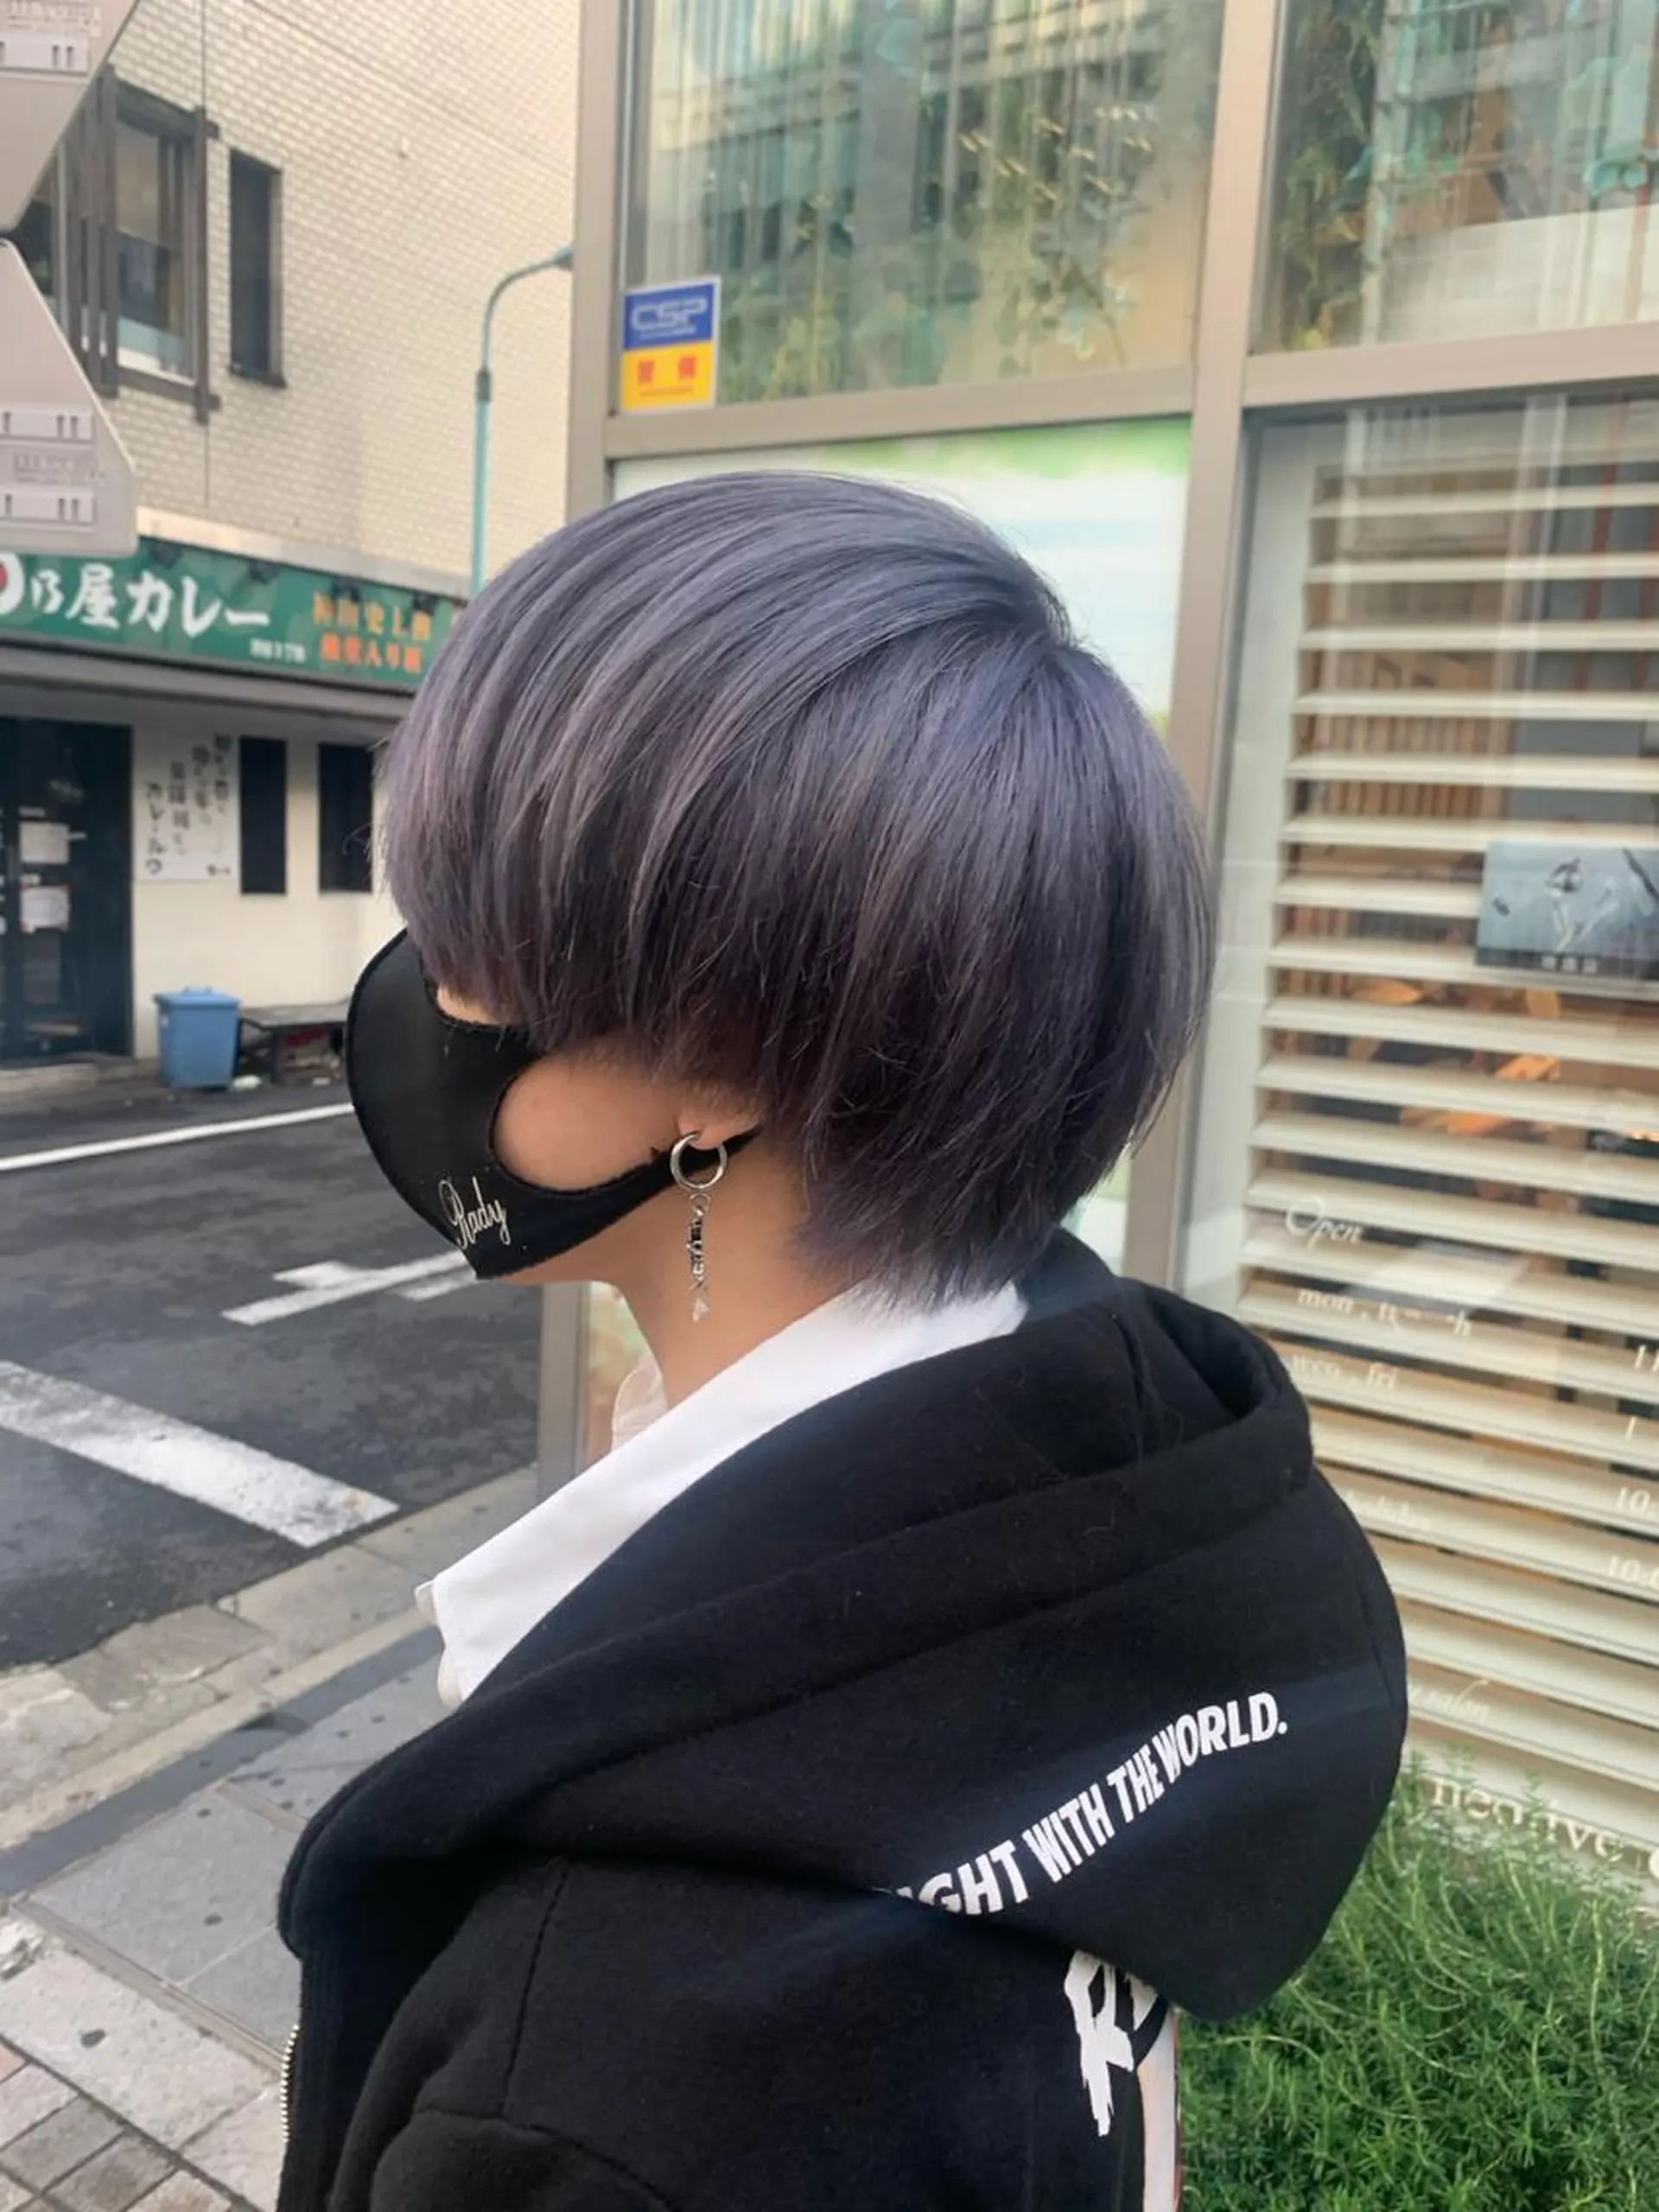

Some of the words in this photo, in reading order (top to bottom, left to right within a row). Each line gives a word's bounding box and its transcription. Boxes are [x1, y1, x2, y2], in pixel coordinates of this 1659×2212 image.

[1286, 1196, 1363, 1250] Open
[1023, 1783, 1115, 1883] WITH
[1107, 1745, 1164, 1822] THE
[1153, 1693, 1287, 1783] WORLD.
